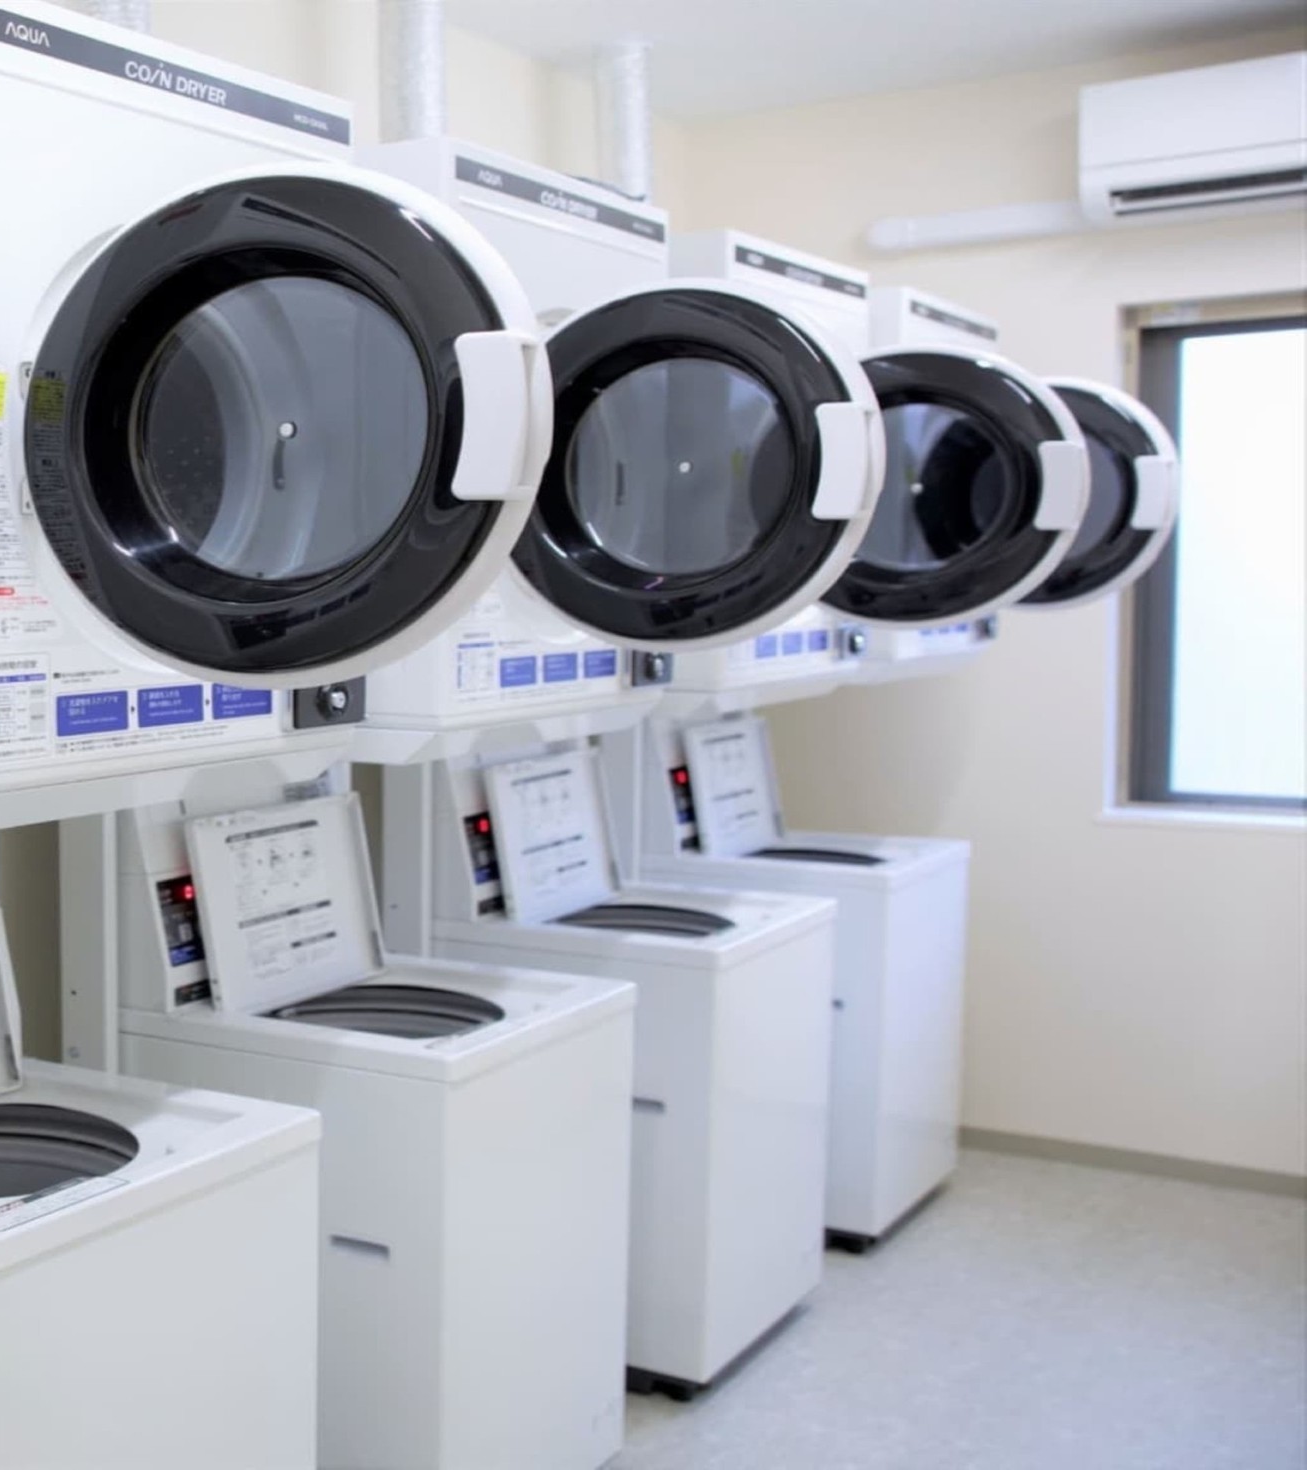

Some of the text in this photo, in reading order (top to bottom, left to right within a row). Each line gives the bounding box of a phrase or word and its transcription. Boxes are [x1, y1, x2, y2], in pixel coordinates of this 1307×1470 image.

[5, 21, 50, 47] AQUA
[124, 61, 227, 105] COIN DRYER
